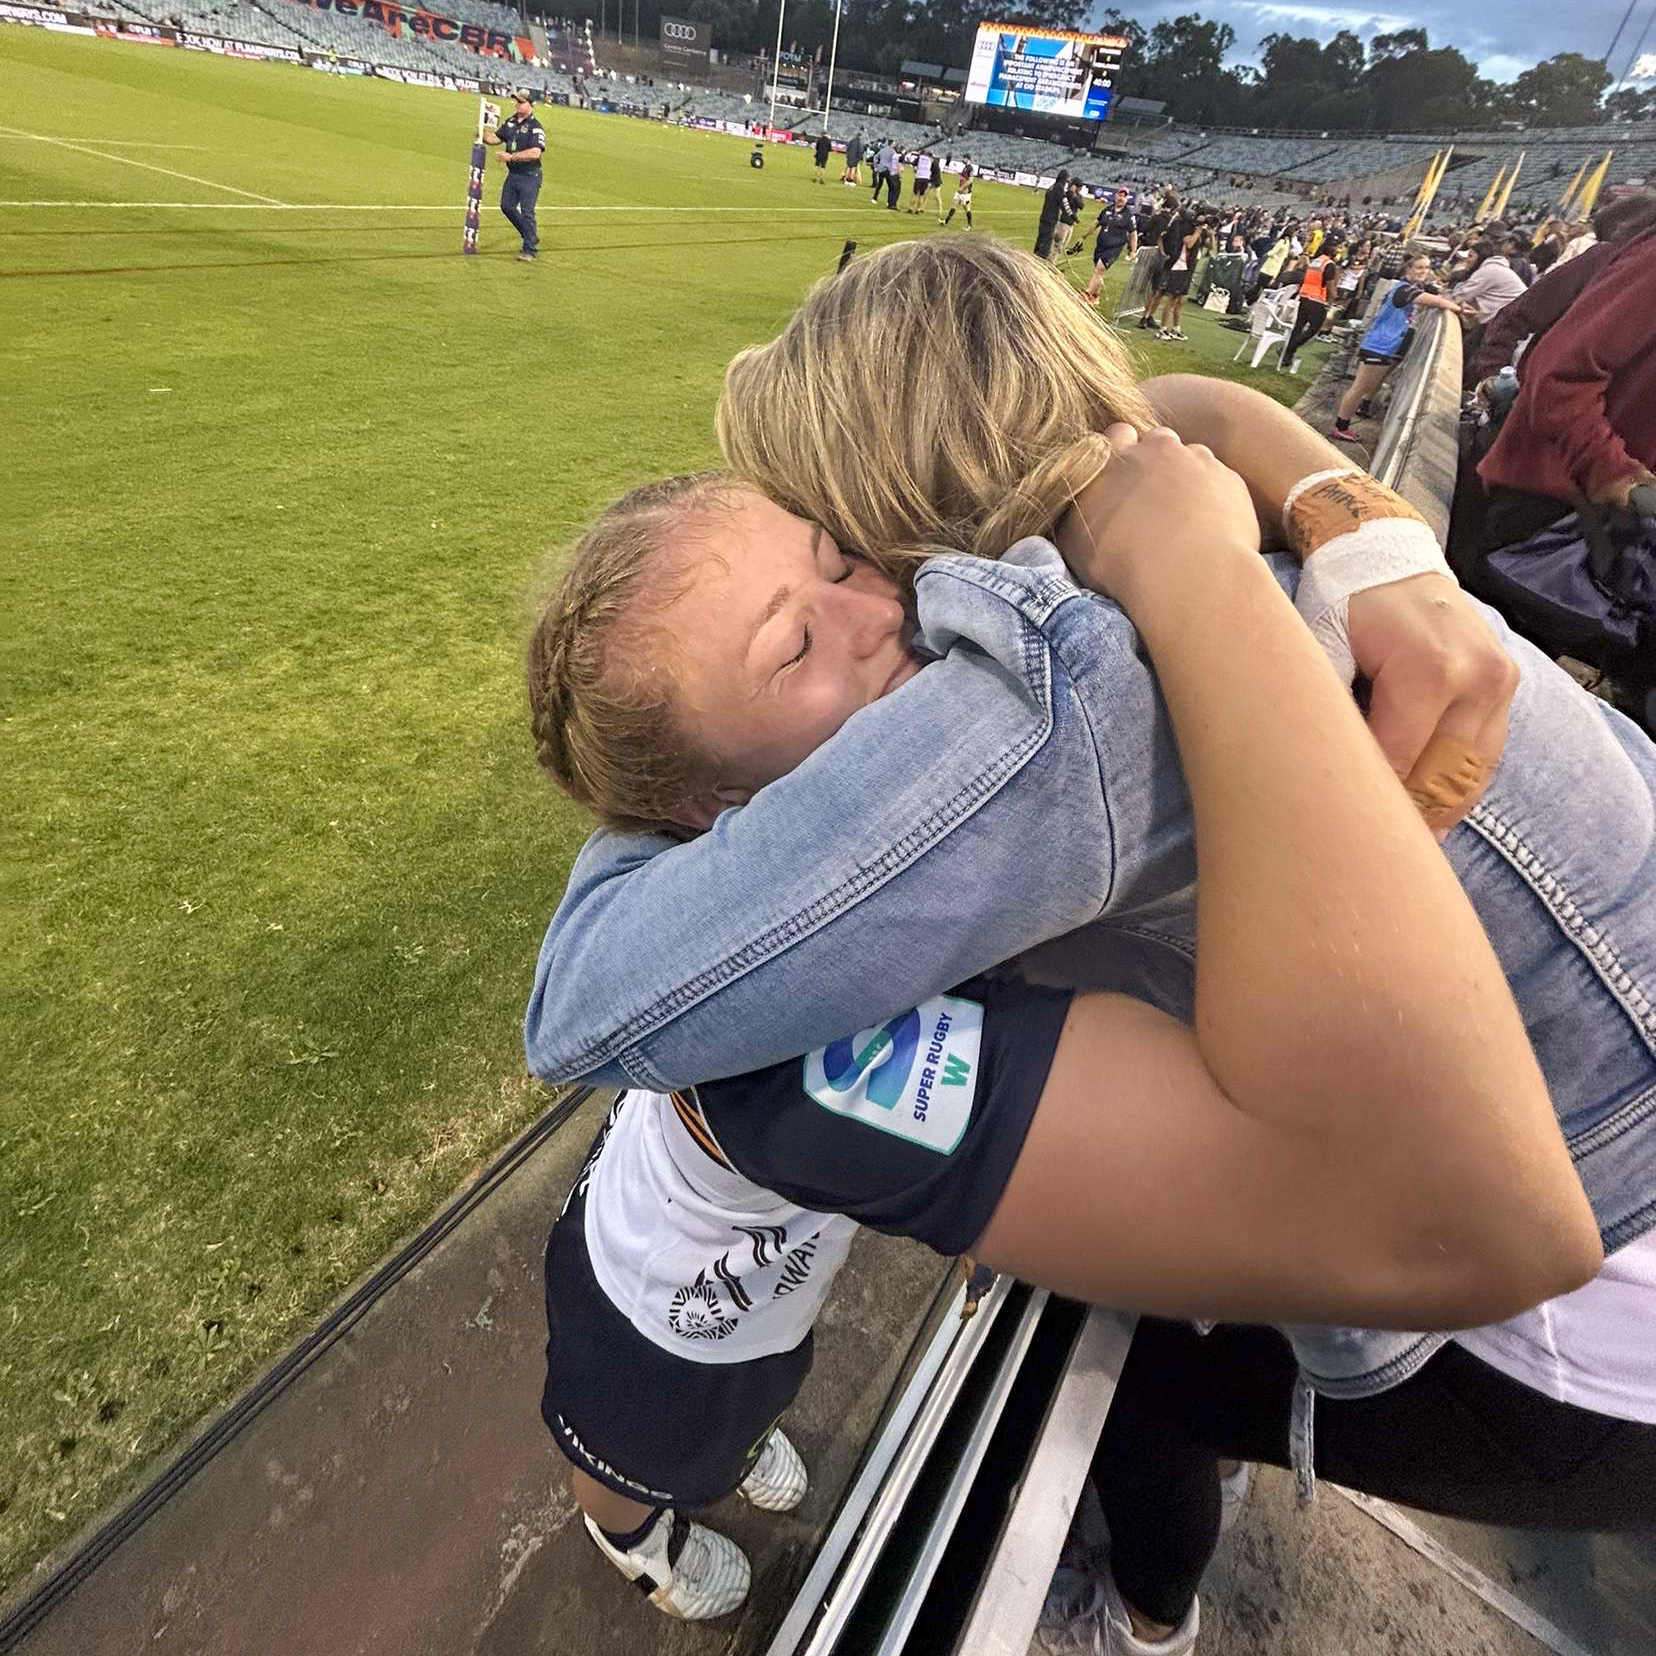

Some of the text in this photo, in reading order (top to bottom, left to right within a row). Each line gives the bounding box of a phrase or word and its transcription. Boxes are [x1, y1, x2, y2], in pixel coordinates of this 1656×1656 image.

[314, 0, 514, 62] eAreCBR
[914, 1012, 953, 1122] SUPER RUGBY
[941, 1053, 972, 1087] W
